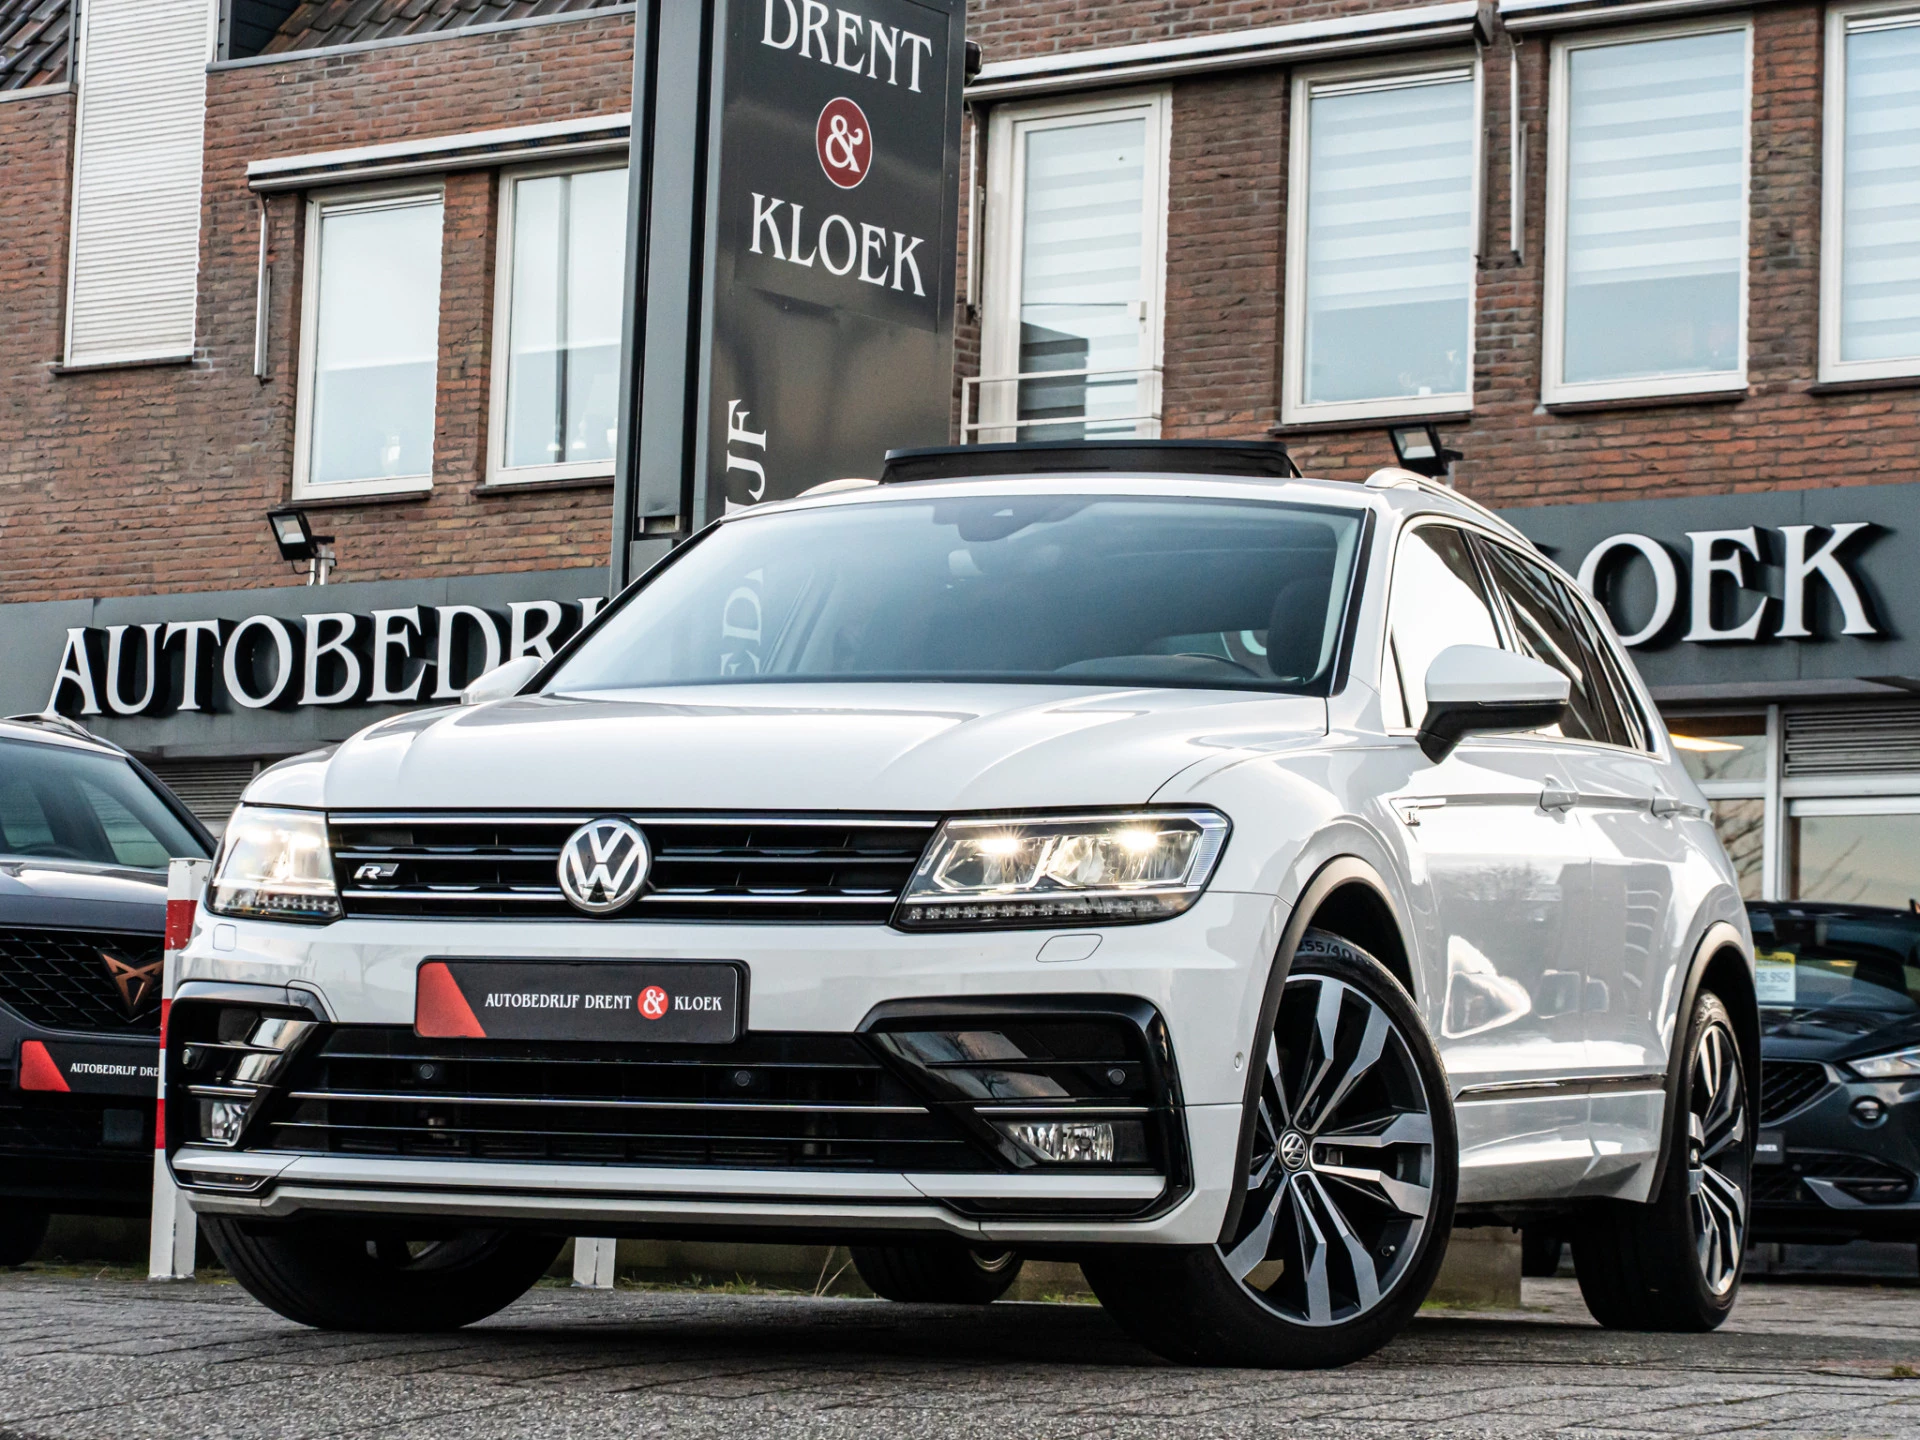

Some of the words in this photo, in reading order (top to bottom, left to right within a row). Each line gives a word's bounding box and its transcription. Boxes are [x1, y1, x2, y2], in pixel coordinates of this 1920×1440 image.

[761, 0, 932, 93] DRENT
[825, 114, 863, 173] &
[750, 192, 926, 297] KLOEK
[485, 993, 580, 1009] AUTOBEDRIJF
[584, 994, 632, 1009] DRENT
[643, 989, 665, 1015] &
[674, 996, 722, 1011] KLOEK
[70, 1062, 137, 1076] AUTOBEDRIJF
